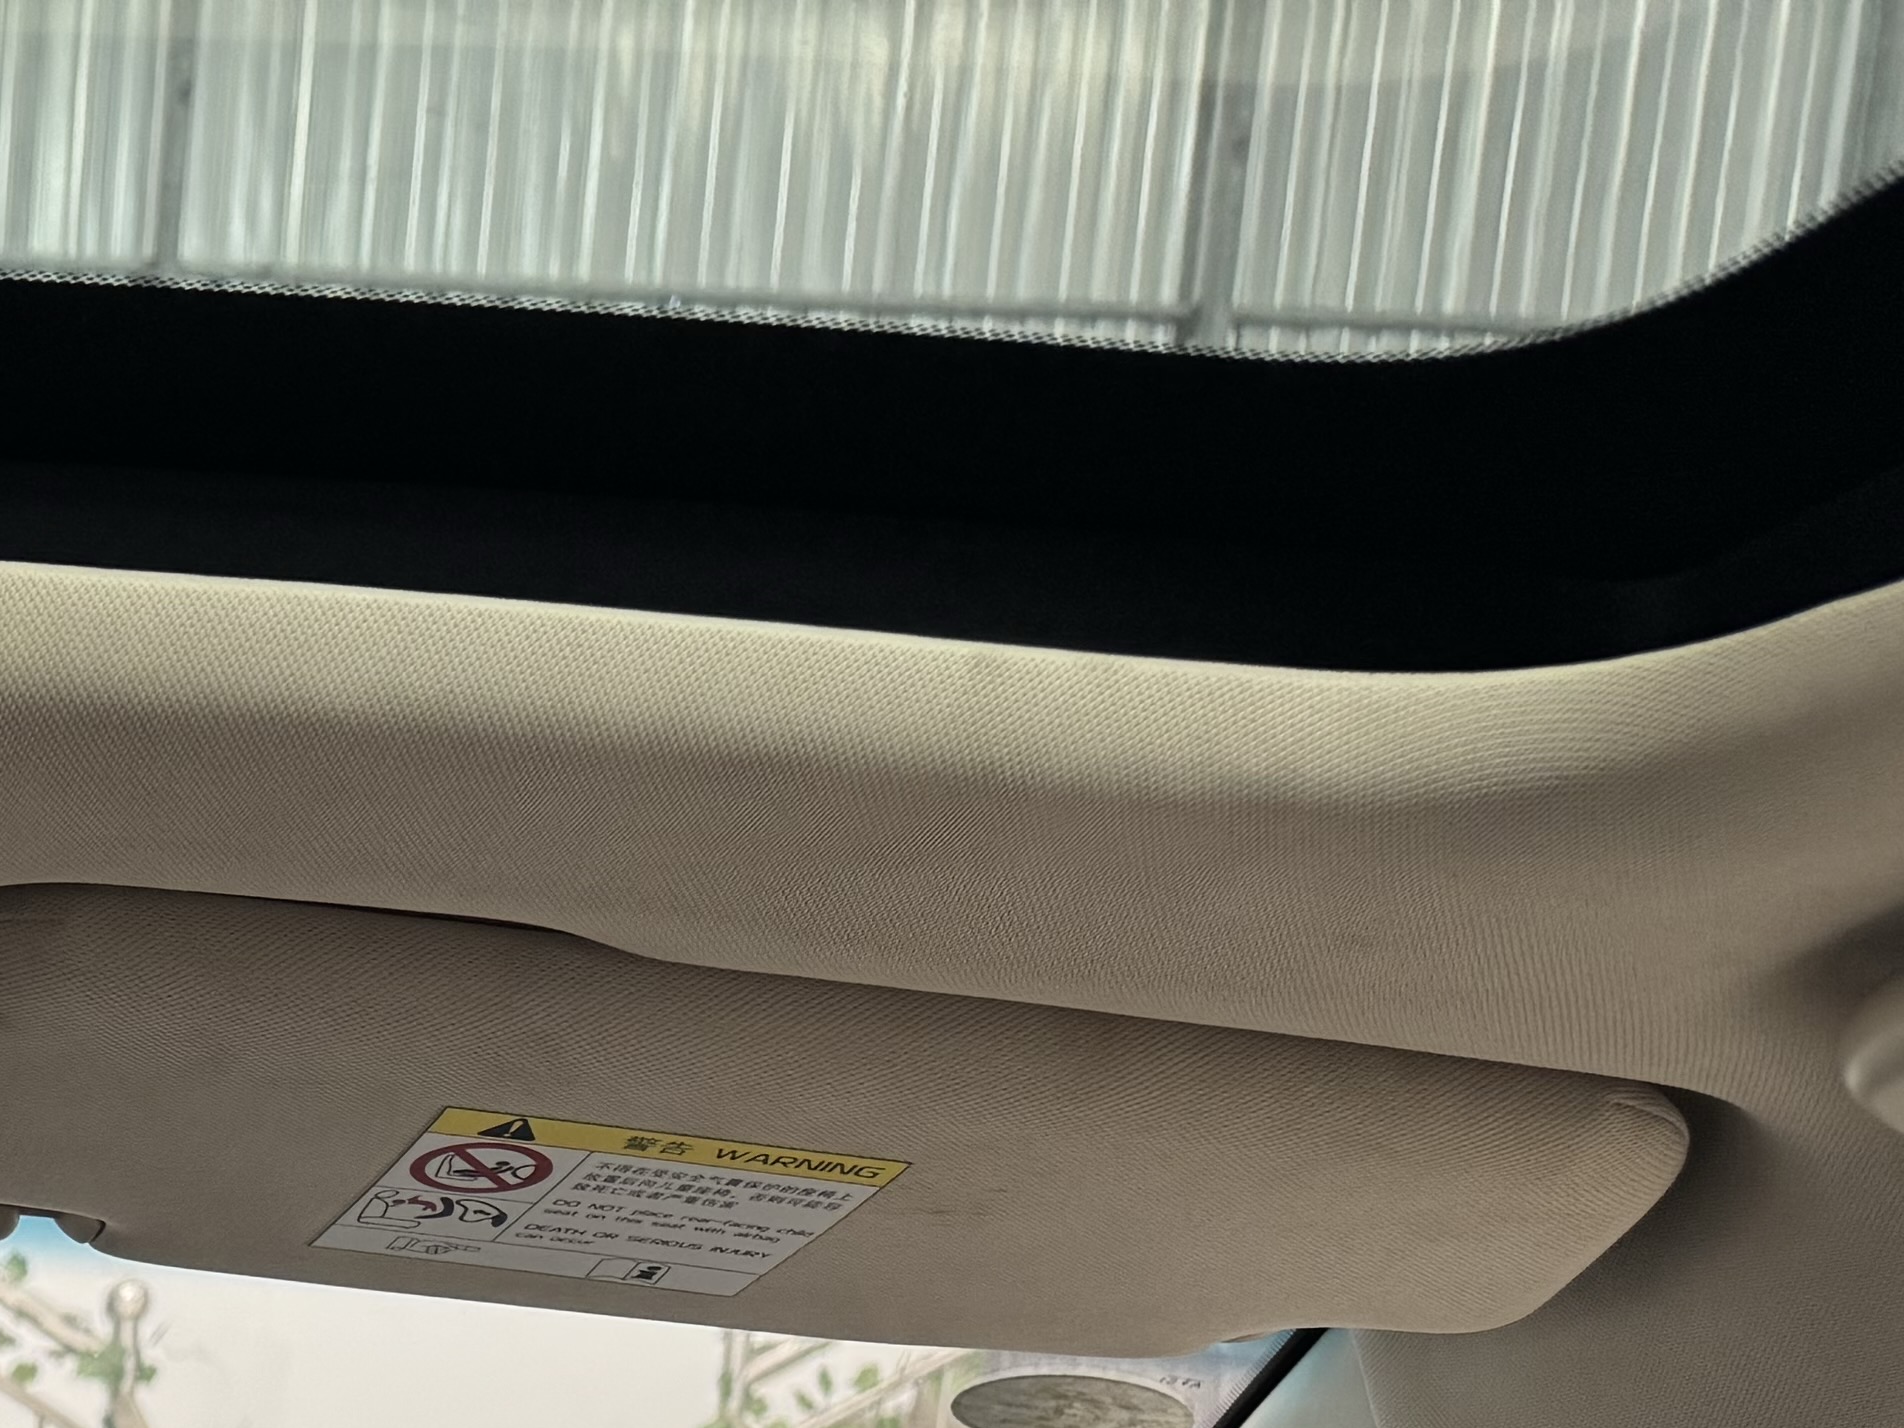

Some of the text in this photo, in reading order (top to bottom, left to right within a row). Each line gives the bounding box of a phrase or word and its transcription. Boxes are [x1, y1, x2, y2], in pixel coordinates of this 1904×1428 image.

[623, 1135, 886, 1179] 警告 WARNING
[552, 1198, 581, 1208] DO
[587, 1203, 626, 1213] NOT
[524, 1223, 773, 1259] DEATH OR SERIOUS INJURY
